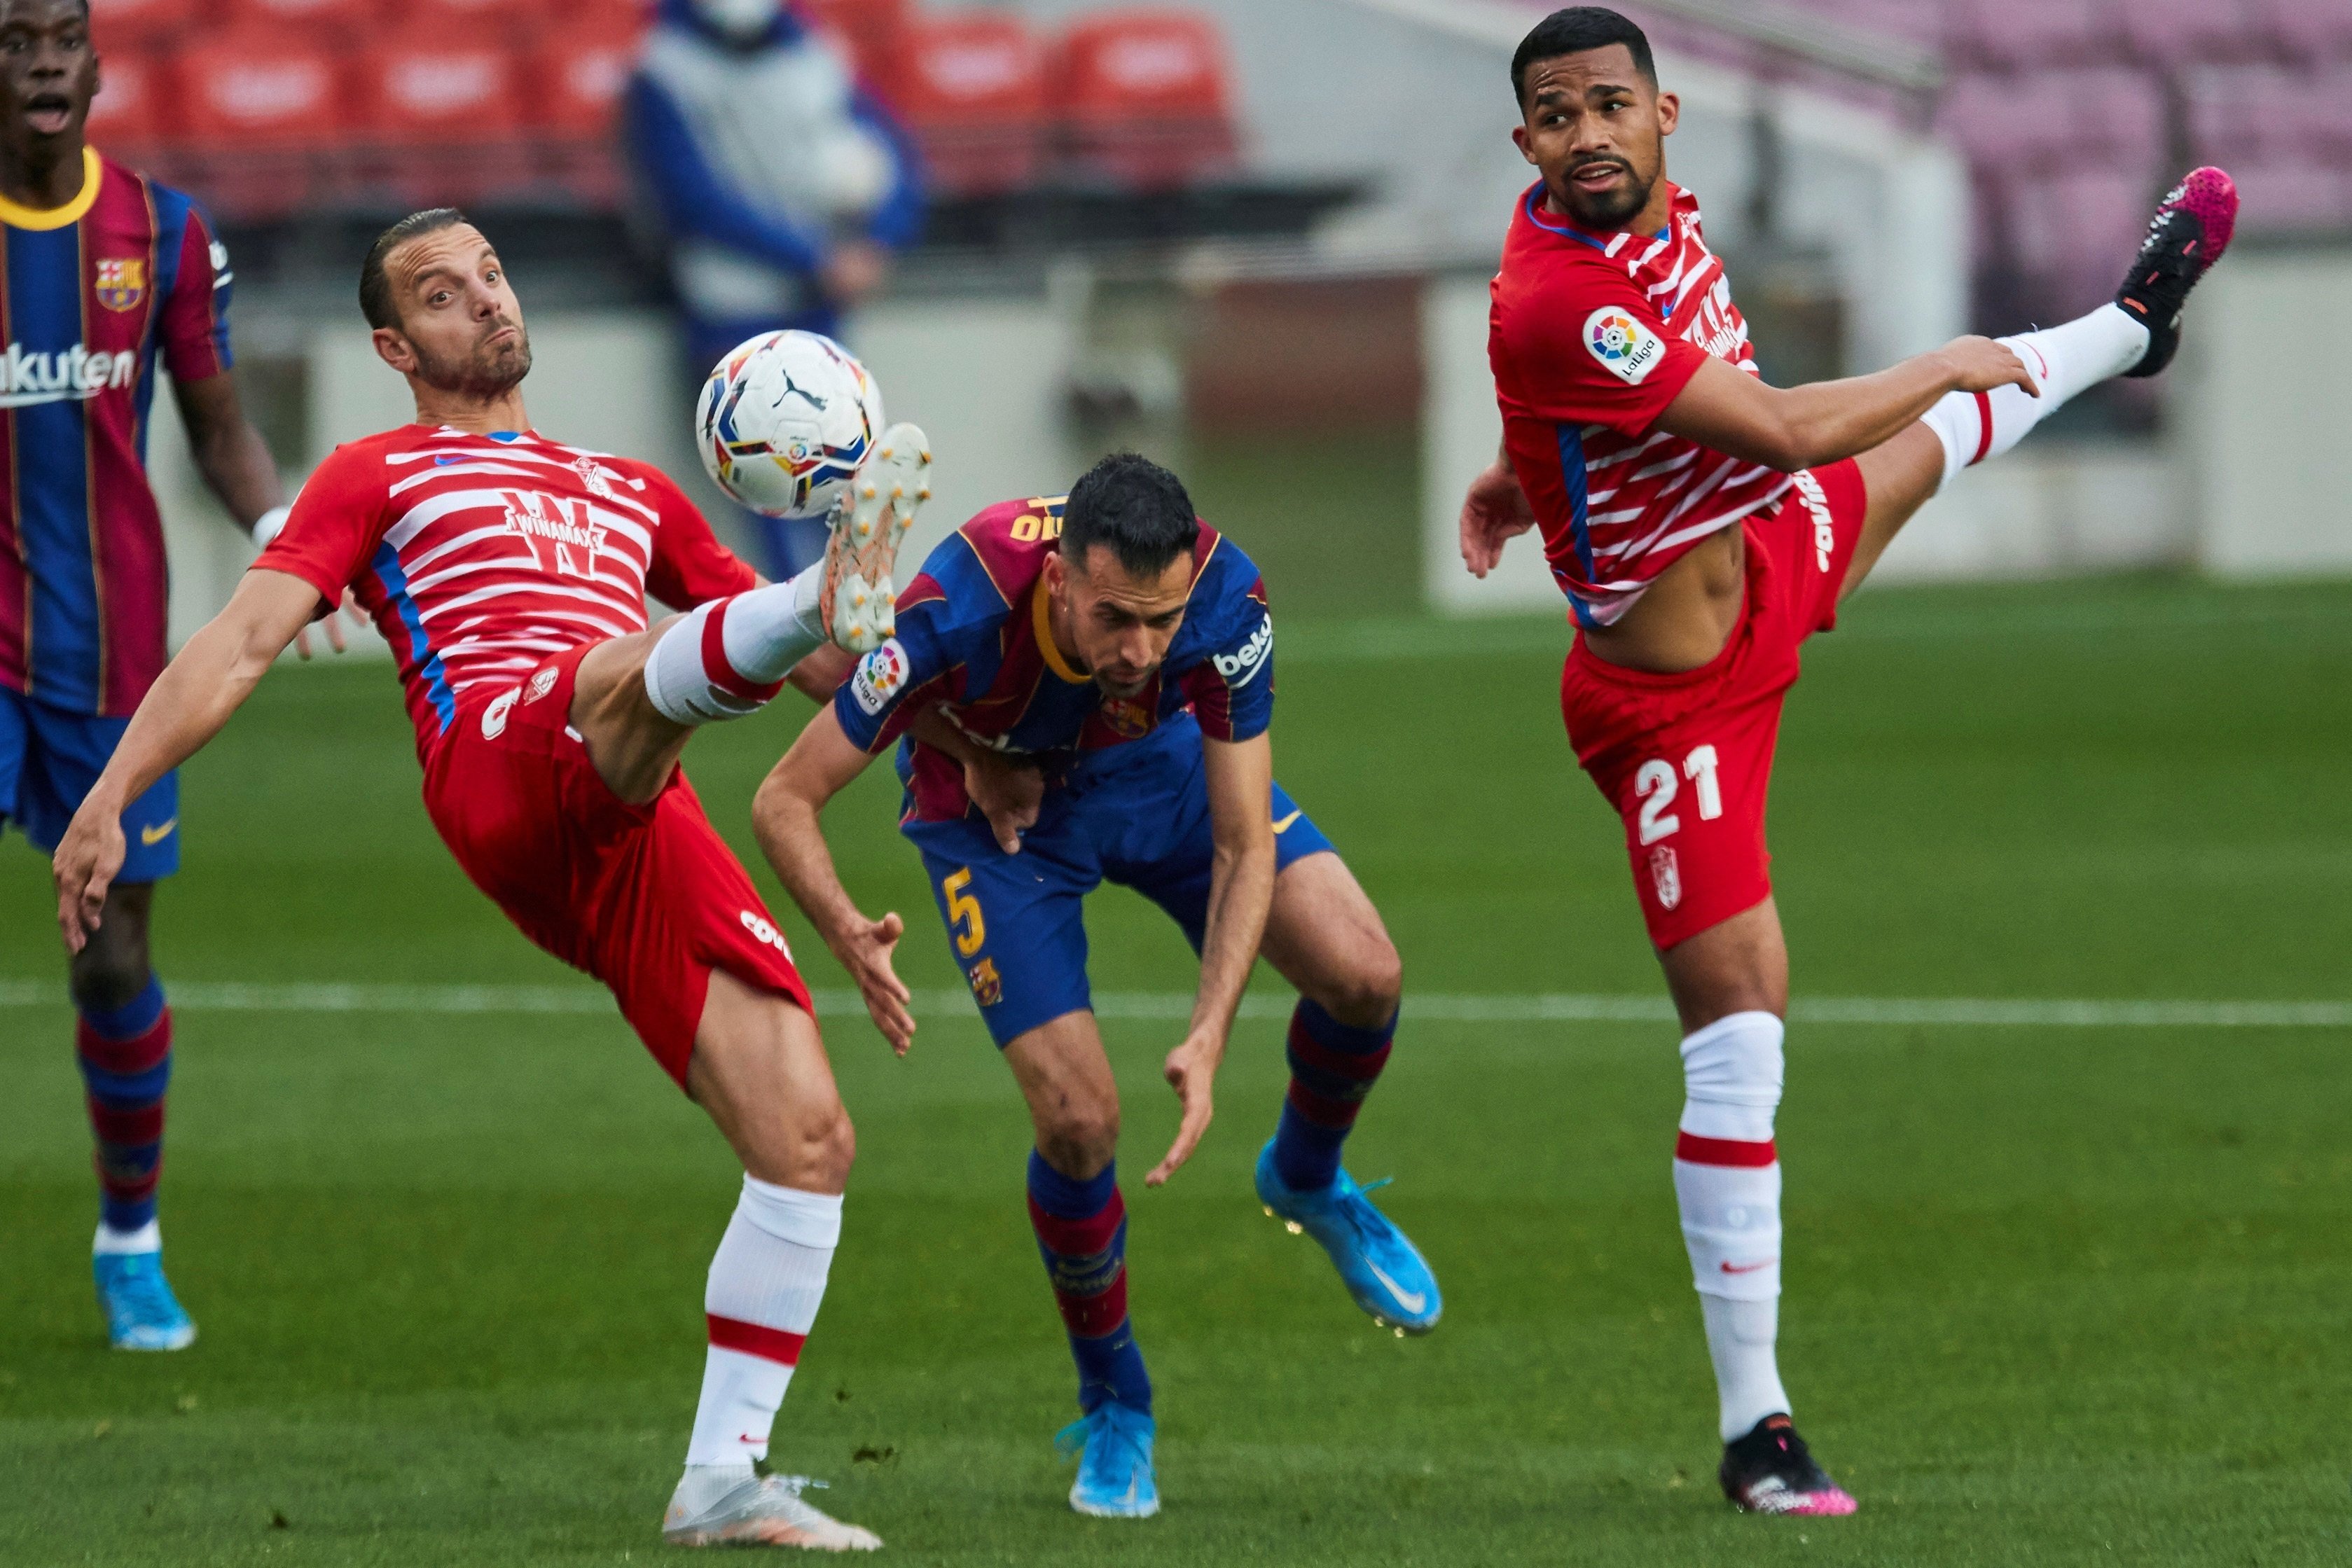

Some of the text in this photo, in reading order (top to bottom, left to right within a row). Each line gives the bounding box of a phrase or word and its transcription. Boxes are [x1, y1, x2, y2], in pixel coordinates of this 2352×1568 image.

[0, 342, 135, 391] kuten
[1621, 340, 1655, 376] LaLiga
[516, 513, 592, 550] WINAMAX
[1212, 613, 1272, 677] beko
[856, 669, 878, 706] aLiga
[1635, 744, 1723, 847] 21
[941, 866, 987, 959] 5
